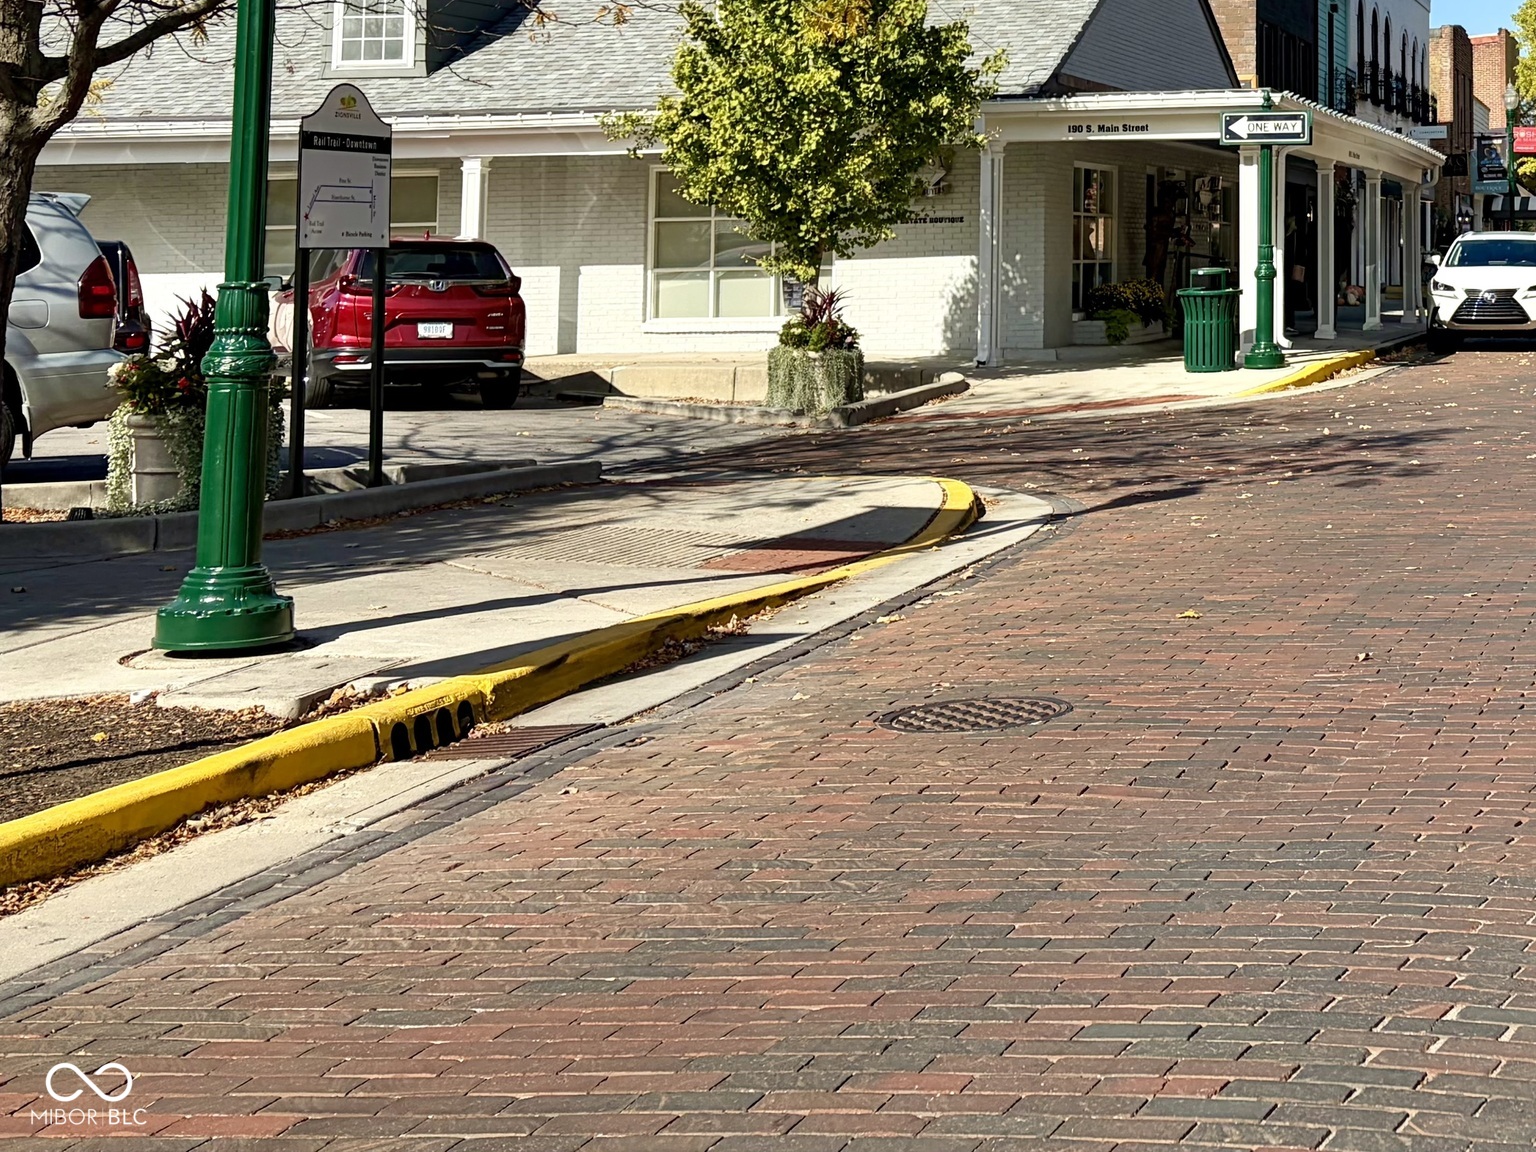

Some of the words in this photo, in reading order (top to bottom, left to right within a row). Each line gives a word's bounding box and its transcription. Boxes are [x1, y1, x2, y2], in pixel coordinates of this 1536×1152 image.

[1068, 124, 1083, 133] 190
[1086, 124, 1095, 133] S.
[1097, 124, 1120, 133] Main
[1122, 123, 1149, 132] Street
[1248, 122, 1269, 132] ONE
[1273, 122, 1297, 132] WAY
[313, 135, 326, 146] Rail
[327, 136, 341, 147] Trail
[346, 138, 377, 150] Downtown
[929, 216, 965, 224] BOUTIQUE
